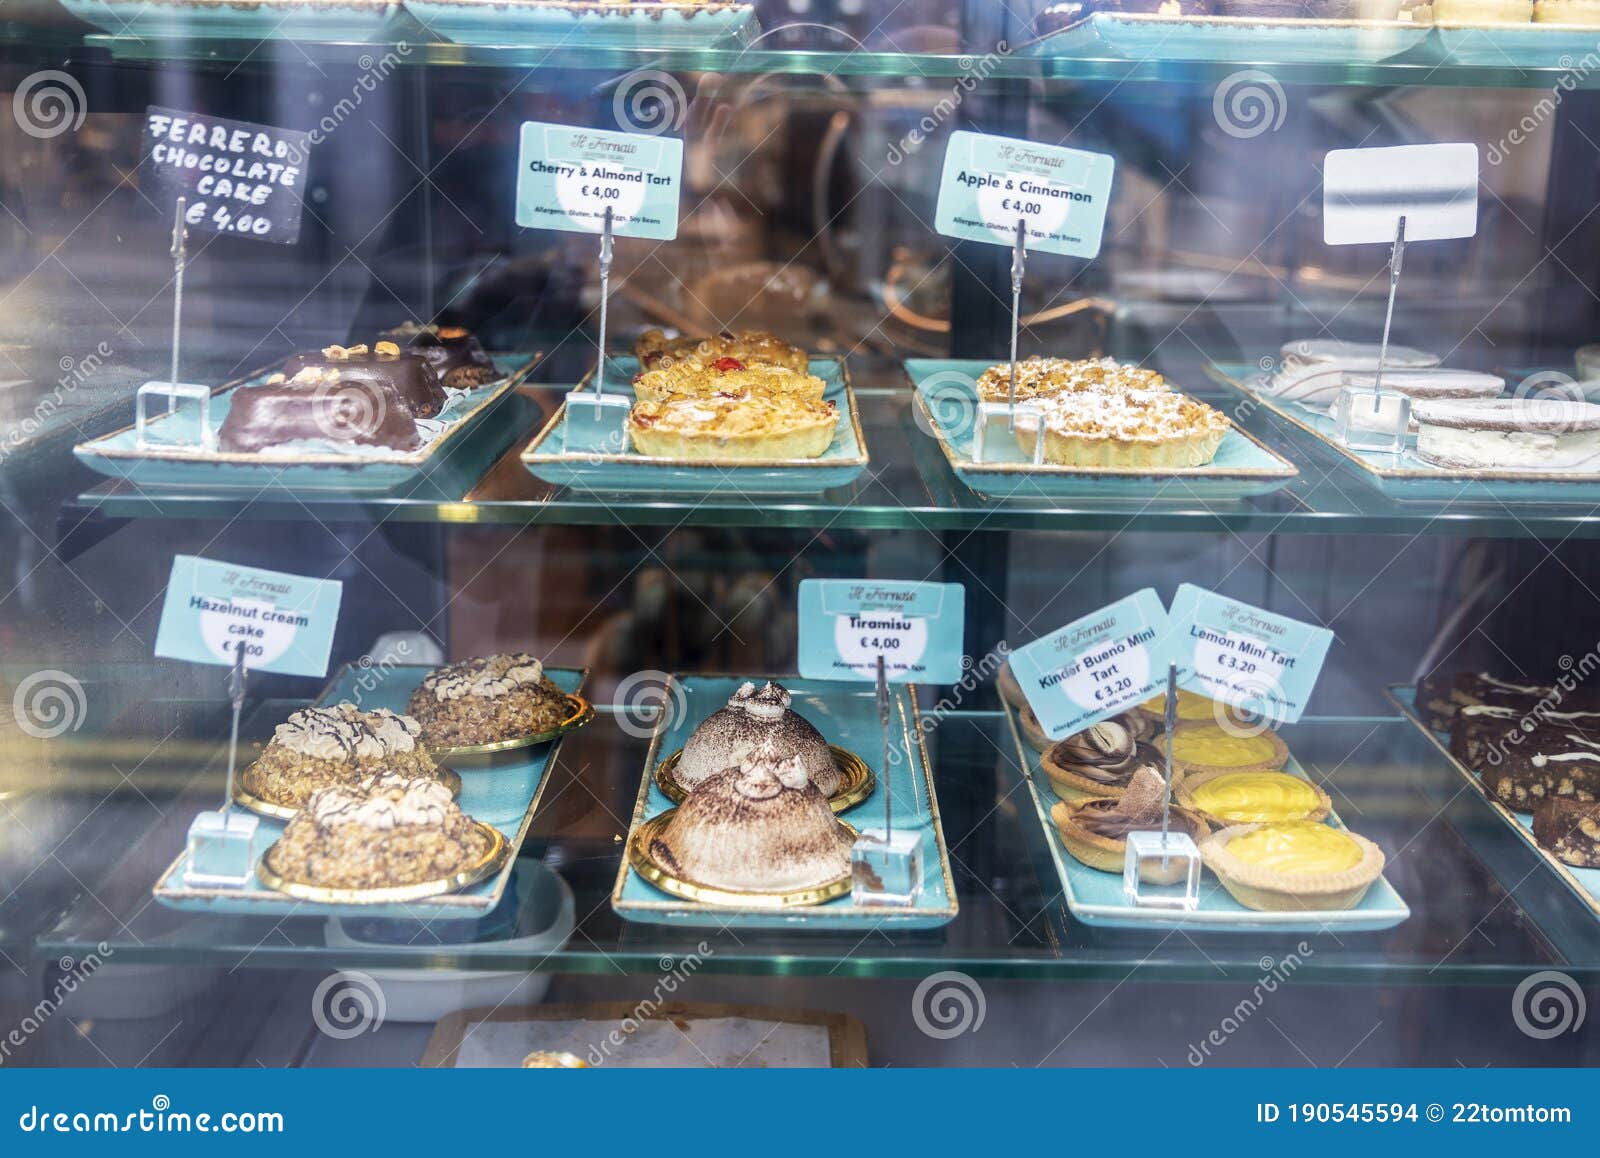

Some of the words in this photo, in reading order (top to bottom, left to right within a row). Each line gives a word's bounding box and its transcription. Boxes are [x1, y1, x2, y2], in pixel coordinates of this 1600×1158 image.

[149, 115, 288, 158] FERRERO
[152, 144, 300, 186] CHOCOLATE
[530, 161, 575, 178] Cherry
[580, 167, 588, 176] &
[592, 168, 642, 183] Almond
[646, 173, 671, 186] Tart
[197, 175, 273, 205] CAKE
[581, 186, 589, 196] €
[592, 186, 620, 200] 4,00
[956, 171, 1000, 189] Apple
[1005, 179, 1014, 190] &
[1020, 181, 1092, 203] Cinnamon
[185, 202, 208, 224] €
[212, 206, 272, 234] 4.00
[1002, 199, 1010, 210] €
[1012, 200, 1041, 215] 4,00
[190, 596, 258, 619] Hazelnut
[262, 609, 309, 627] cream
[849, 616, 912, 630] Tiramisu
[228, 623, 264, 638] cake
[860, 637, 868, 648] €
[871, 637, 900, 650] 4,00
[1190, 625, 1235, 649] Lemon
[1238, 641, 1266, 659] Mini
[1271, 651, 1296, 669] Tart
[1039, 664, 1081, 689] Kinder
[1083, 643, 1125, 669] Bueno
[1127, 626, 1156, 648] Mini
[1218, 654, 1226, 665] €
[1228, 656, 1256, 674] 3.20
[1091, 664, 1119, 683] Tart
[1094, 689, 1104, 701] €
[1105, 677, 1132, 697] 3.20
